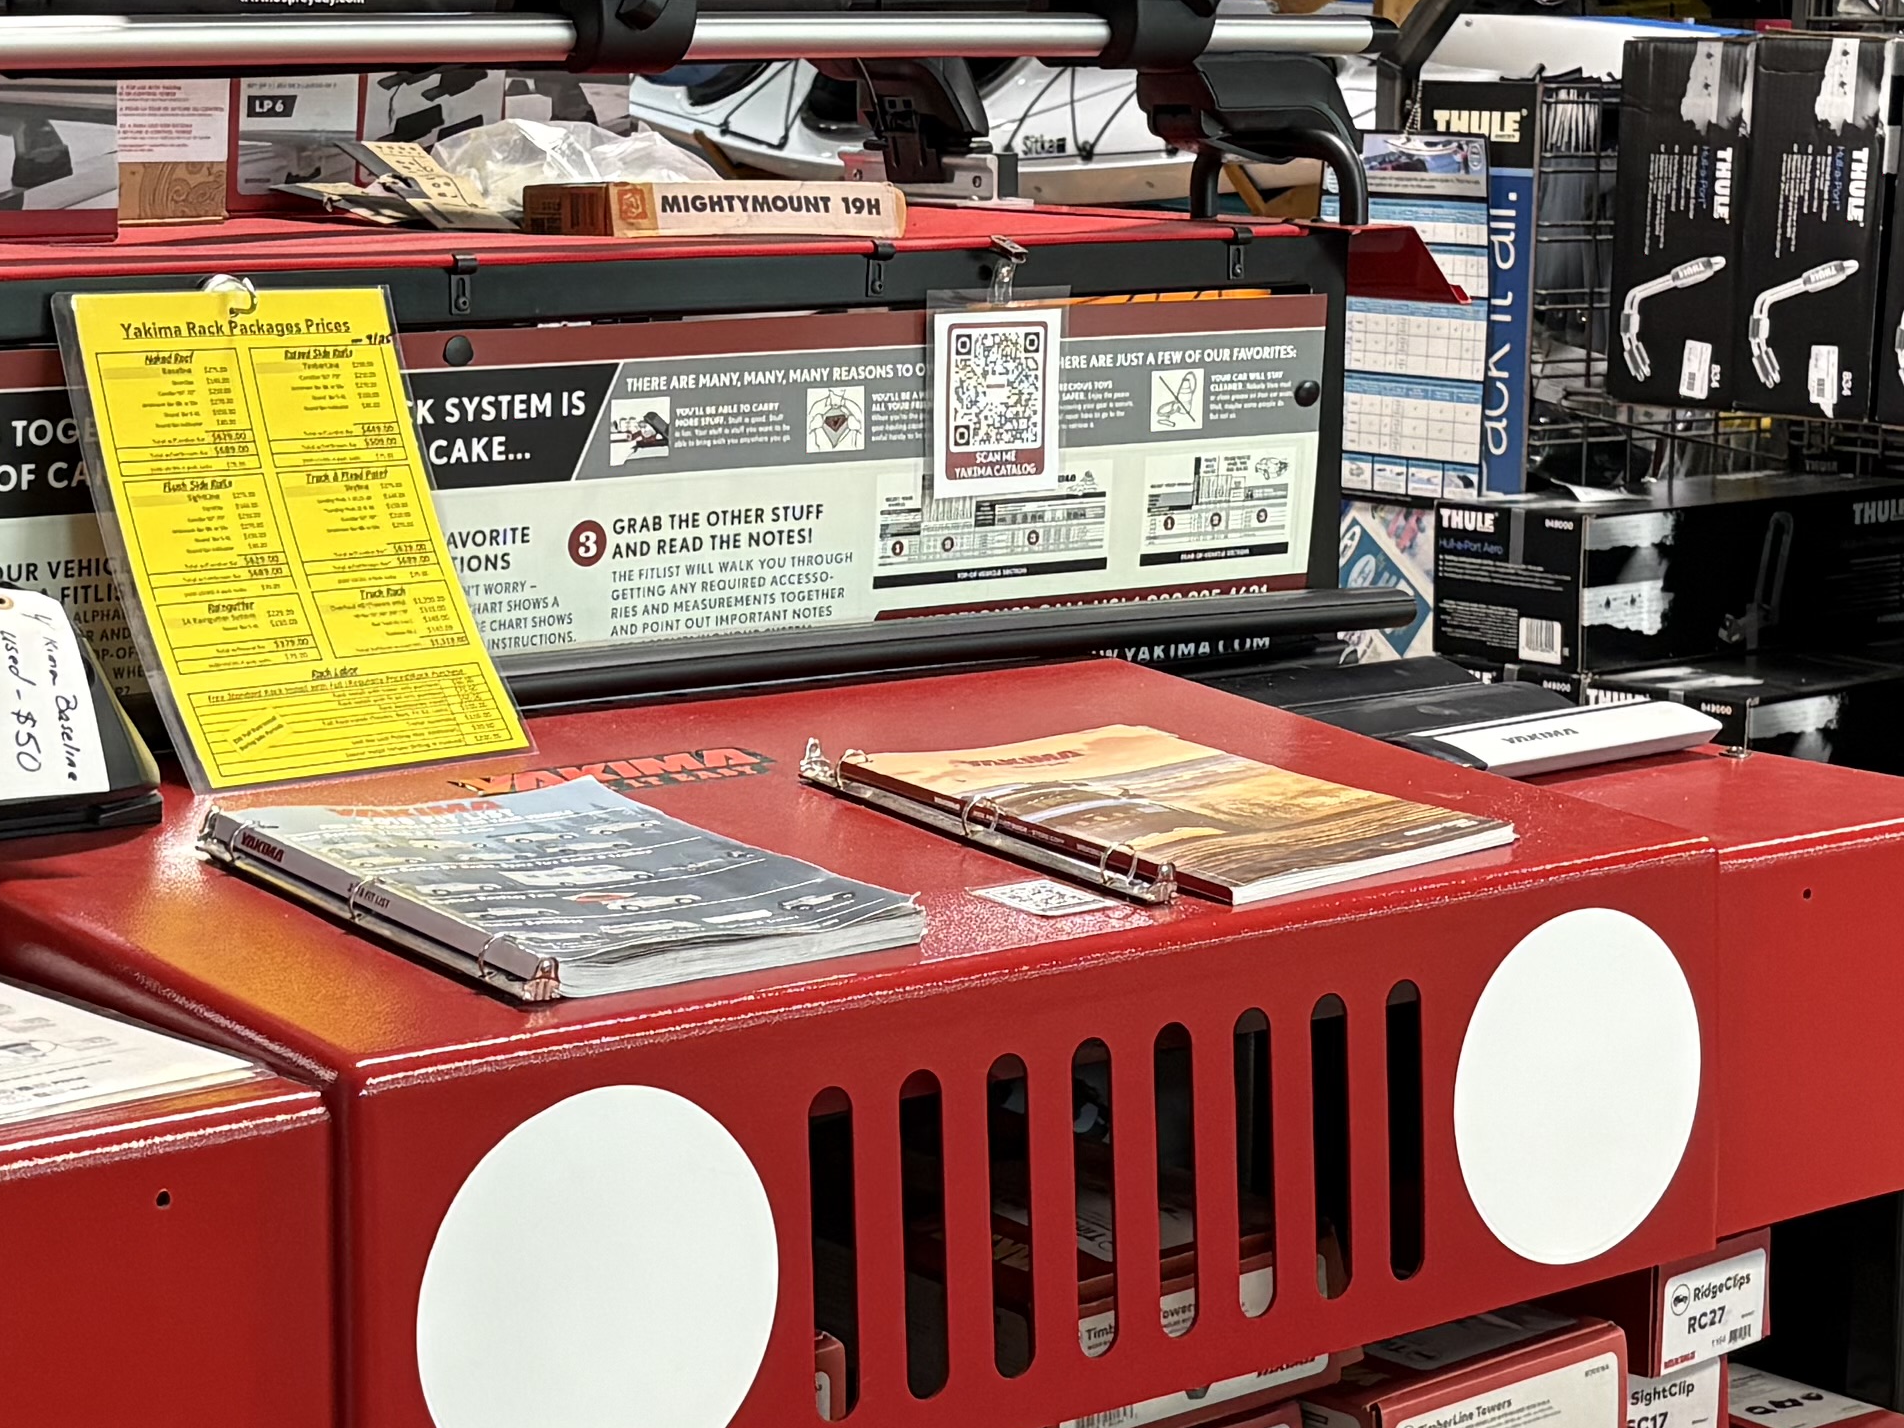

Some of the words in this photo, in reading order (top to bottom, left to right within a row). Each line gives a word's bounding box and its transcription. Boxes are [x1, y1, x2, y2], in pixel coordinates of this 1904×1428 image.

[1434, 106, 1523, 143] THULE
[660, 192, 832, 217] MIGHTYMOUNT
[841, 193, 883, 217] 19H
[121, 321, 181, 339] Yakima
[187, 321, 225, 338] Rack
[228, 319, 302, 337] Packages
[305, 318, 352, 334] Prices
[627, 376, 668, 392] THERE
[670, 374, 696, 389] ARE
[699, 373, 740, 389] MANY,
[744, 370, 787, 387] MANY,
[789, 368, 830, 383] MANY
[833, 365, 893, 381] REASONS
[445, 391, 553, 424] SYSTEM
[562, 390, 586, 417] IS
[429, 437, 531, 466] CAKE...
[976, 450, 1002, 464] SCAN
[1004, 450, 1016, 463] ME
[954, 464, 994, 478] YAKIMA
[996, 463, 1037, 476] CATALOG
[612, 516, 663, 535] GRAB
[669, 512, 701, 530] THE
[706, 508, 764, 528] OTHER
[771, 504, 824, 522] STUFF
[612, 541, 650, 559] AND
[656, 538, 704, 556] READ
[709, 535, 742, 552] THE
[748, 530, 813, 549] NOTES!
[612, 571, 635, 582] THE
[639, 565, 681, 580] FITLIST
[685, 562, 712, 577] WILL
[716, 558, 753, 574] WALK
[759, 556, 786, 571] YOU
[790, 551, 852, 568] THROUGH
[612, 584, 666, 601] GETTING
[670, 582, 696, 596] ANY
[701, 576, 765, 594] REQUIRED
[772, 572, 833, 588] ACCESSO-
[10, 710, 42, 772] $50
[1692, 1270, 1752, 1304] RidgeClips
[1686, 1307, 1726, 1335] RC27
[1477, 1396, 1513, 1418] Towers
